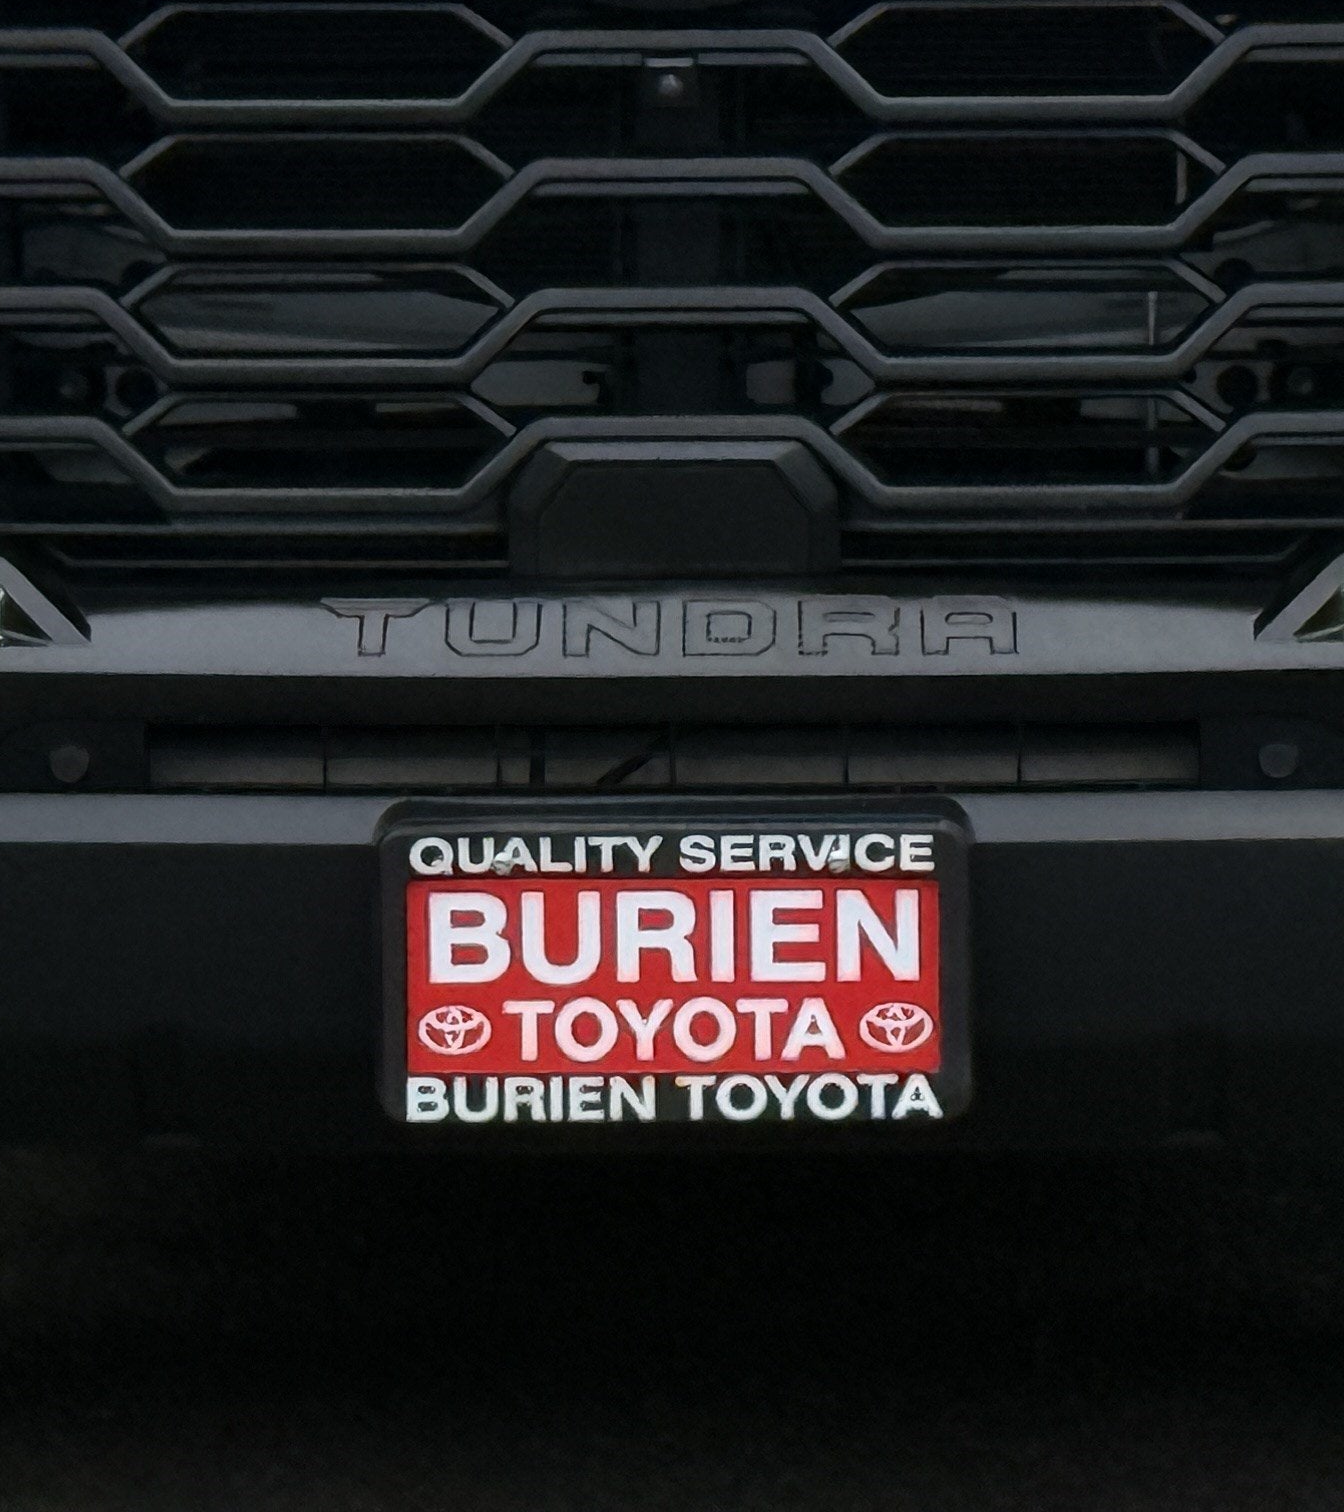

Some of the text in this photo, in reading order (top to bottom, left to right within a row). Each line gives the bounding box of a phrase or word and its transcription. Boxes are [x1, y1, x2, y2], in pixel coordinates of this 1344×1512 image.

[319, 594, 1019, 658] TUNDRA
[408, 833, 935, 876] QUALITY SERVICE
[428, 888, 921, 984] BURIEN
[502, 996, 846, 1062] TOYOTA
[406, 1073, 943, 1123] BURIEN TOYOTA
